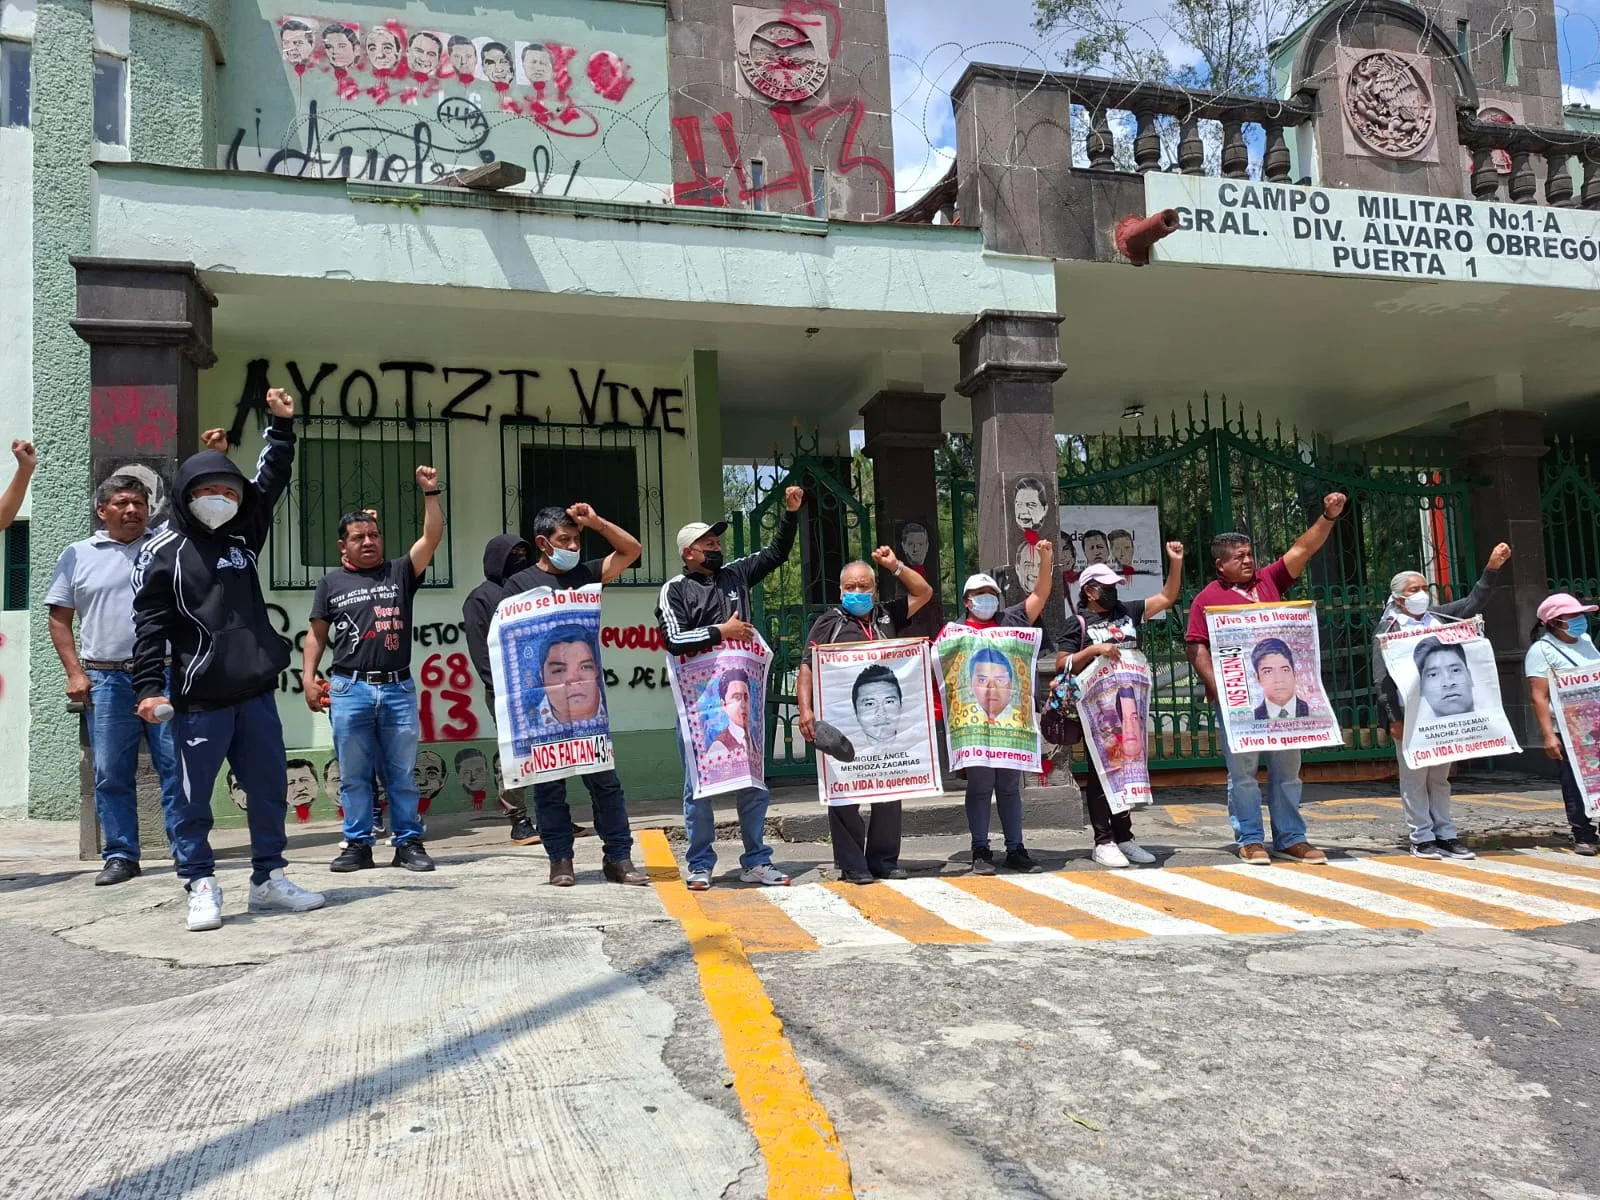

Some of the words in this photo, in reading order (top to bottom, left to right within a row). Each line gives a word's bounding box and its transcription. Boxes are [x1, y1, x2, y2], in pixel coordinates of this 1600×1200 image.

[1218, 183, 1330, 215] CAMPO
[1358, 196, 1474, 226] MILITAR
[1174, 207, 1268, 236] GRAL.
[1293, 217, 1345, 242] DIV.
[1363, 218, 1473, 252] ÁLVARO
[1487, 232, 1600, 262] OBREGÓ
[1333, 247, 1446, 275] PUERTA
[1465, 256, 1478, 278] 1
[227, 358, 540, 447] AYOTZI
[570, 368, 686, 436] VIVE
[500, 601, 532, 620] ¡Vivo
[536, 596, 550, 608] se
[552, 592, 566, 604] lo
[1216, 616, 1242, 628] ¡Vivo
[1245, 615, 1257, 624] se
[1260, 612, 1269, 622] lo
[1272, 611, 1311, 622] llevaron!
[821, 653, 849, 664] ¡Vivo
[852, 653, 864, 661] se
[867, 651, 878, 660] lo
[881, 646, 921, 660] llevaron!
[420, 652, 473, 690] 68
[1222, 657, 1246, 688] FALTAN
[1557, 674, 1590, 688] ¡Vivo
[1227, 690, 1249, 707] NOS
[418, 689, 480, 741] 13
[1240, 736, 1265, 748] ¡Vivo
[1267, 735, 1277, 744] lo
[1280, 731, 1331, 746] queremos!
[1413, 750, 1432, 764] ¡Con
[1432, 745, 1454, 758] VIDA
[1455, 743, 1463, 752] lo
[1465, 735, 1508, 753] queremos!
[533, 745, 557, 771] NOS
[559, 738, 595, 767] FALTAN
[841, 763, 881, 771] MENDOZA
[882, 758, 921, 768] ZACARIAS
[973, 747, 983, 756] lo
[986, 749, 1034, 762] queremos!
[830, 781, 849, 794] ¡Con
[852, 779, 874, 790] VIDA
[876, 778, 884, 788] lo
[888, 773, 931, 789] queremos!
